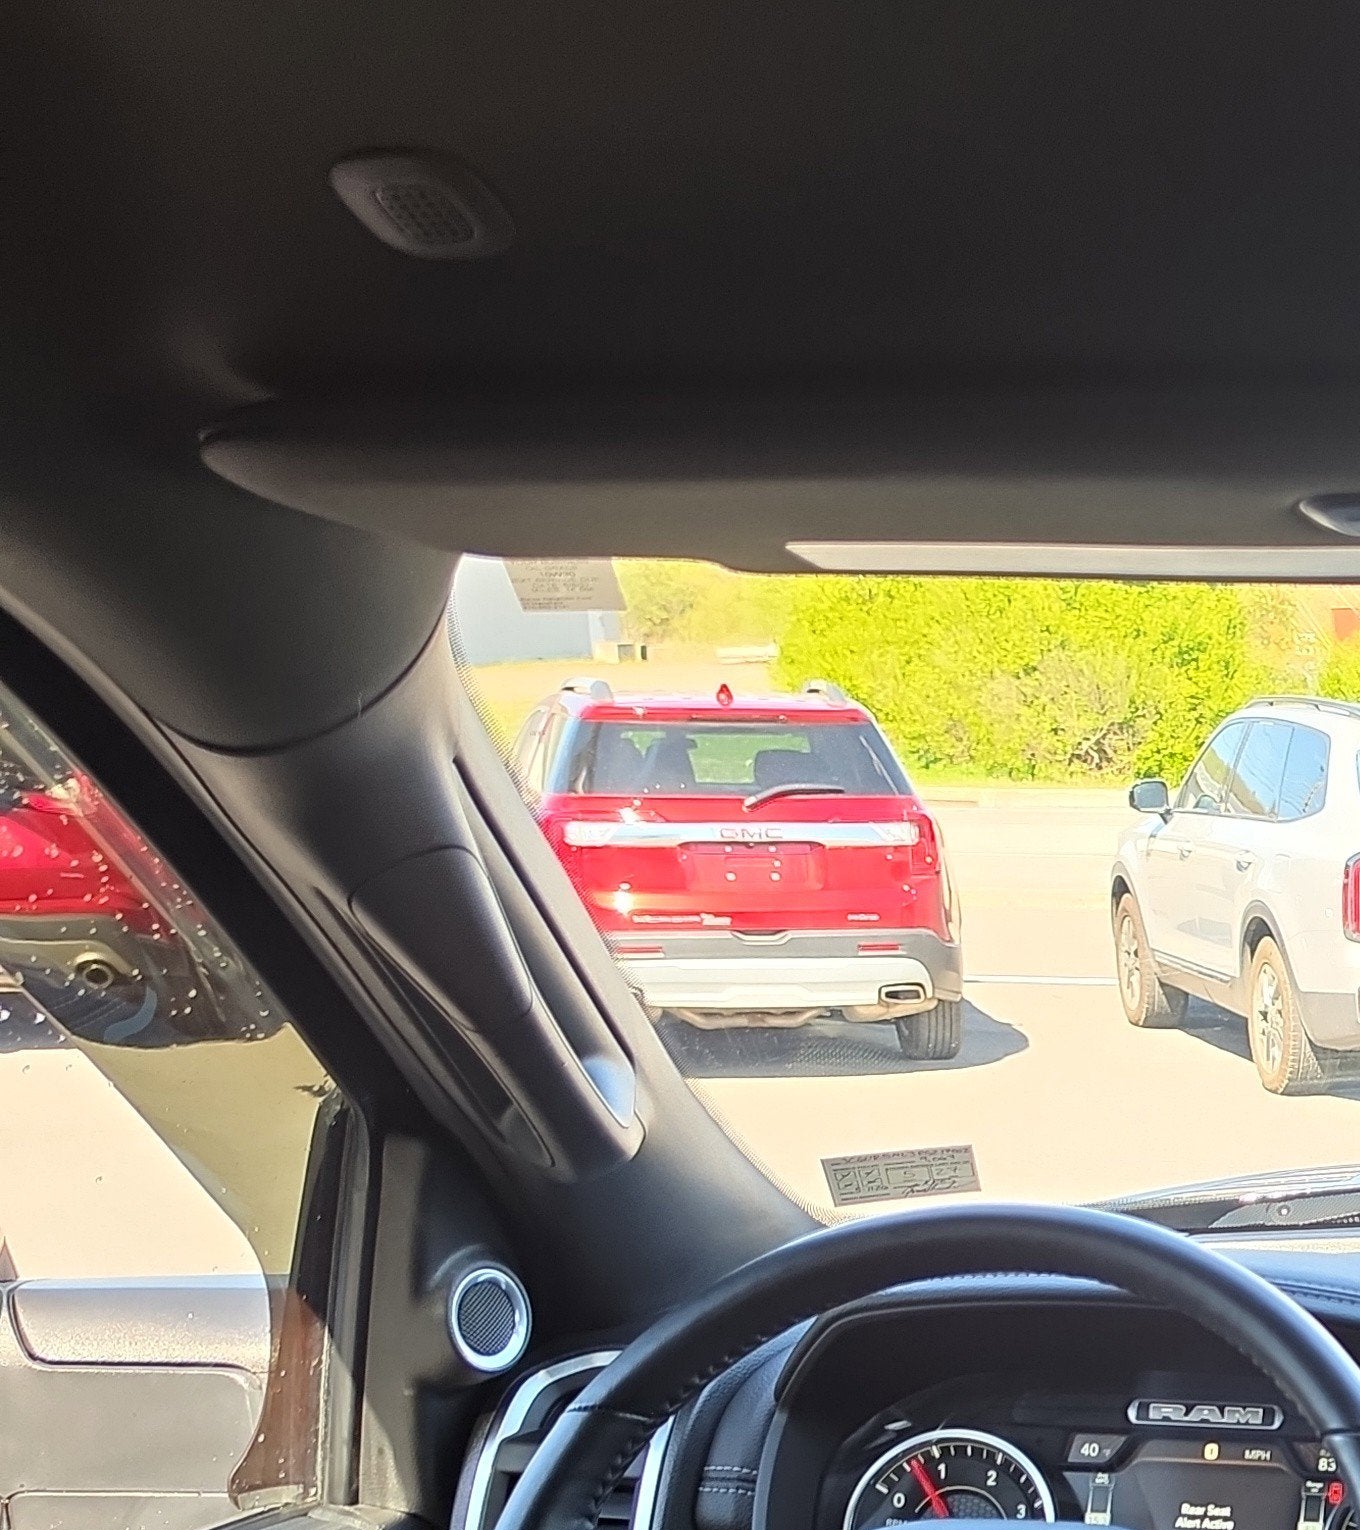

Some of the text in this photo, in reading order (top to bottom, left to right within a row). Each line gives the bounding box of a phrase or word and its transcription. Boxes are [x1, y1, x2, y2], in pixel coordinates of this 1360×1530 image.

[720, 827, 784, 839] GMC
[1148, 1403, 1265, 1425] RAM
[1080, 1443, 1099, 1457] 40
[937, 1463, 946, 1479] 1
[986, 1470, 998, 1486] 2
[893, 1493, 905, 1508] 0
[1016, 1504, 1026, 1519] 3
[1181, 1503, 1232, 1517] Rear Seat
[1174, 1517, 1235, 1530] Alert Active
